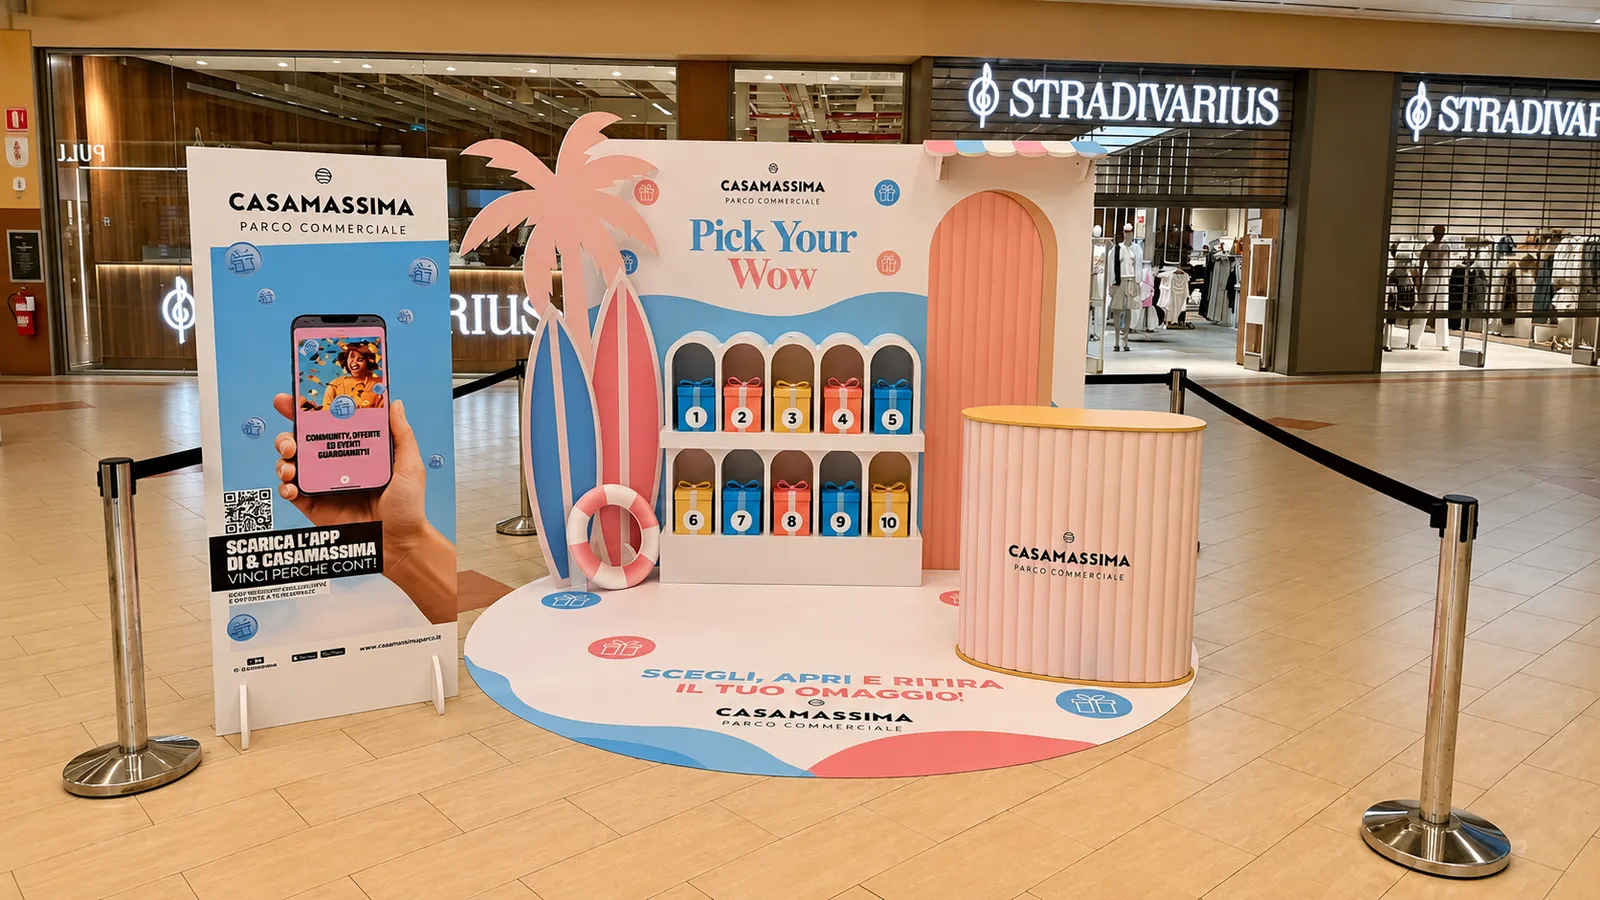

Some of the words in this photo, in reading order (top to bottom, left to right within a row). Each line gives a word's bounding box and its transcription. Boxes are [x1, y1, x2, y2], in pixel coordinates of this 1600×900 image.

[1009, 78, 1279, 126] STRADIVARIUS
[720, 179, 826, 193] CASAMASSIMA
[228, 192, 414, 216] CASAMASSIMA
[725, 197, 754, 205] PARCO
[757, 197, 820, 206] COMMERCIALE
[240, 221, 292, 233] PARCO
[300, 222, 406, 235] COMMERCIALE
[689, 218, 766, 252] Pick
[770, 220, 858, 253] Your
[727, 258, 818, 290] Wow
[692, 411, 699, 423] 1
[738, 411, 747, 423] 2
[788, 412, 797, 424] 3
[838, 413, 848, 424] 4
[888, 414, 897, 425] 5
[689, 514, 698, 525] 6
[737, 515, 746, 526] 7
[787, 516, 796, 527] 8
[836, 516, 845, 527] 9
[881, 517, 896, 528] 10
[226, 534, 295, 555] SCARICA
[297, 530, 340, 547] L'APP
[227, 556, 243, 571] DI
[246, 555, 259, 569] &
[262, 542, 376, 566] CASAMASSIMA
[1008, 544, 1130, 567] CASAMASSIMA
[227, 570, 268, 584] VINCI
[273, 563, 328, 580] PERCHE
[1014, 564, 1046, 575] PARCO
[1051, 568, 1124, 581] COMMERCIALE
[641, 669, 763, 683] SCEGLI,
[773, 673, 851, 684] APRI
[863, 675, 881, 685] E
[893, 676, 1004, 689] RITIRA
[675, 683, 703, 694] IL
[715, 684, 785, 696] TUO
[795, 686, 964, 702] OMAGGIO!
[716, 707, 913, 723] CASAMASSIMA
[722, 720, 776, 728] PARCO
[784, 722, 902, 732] COMMERCIALE
